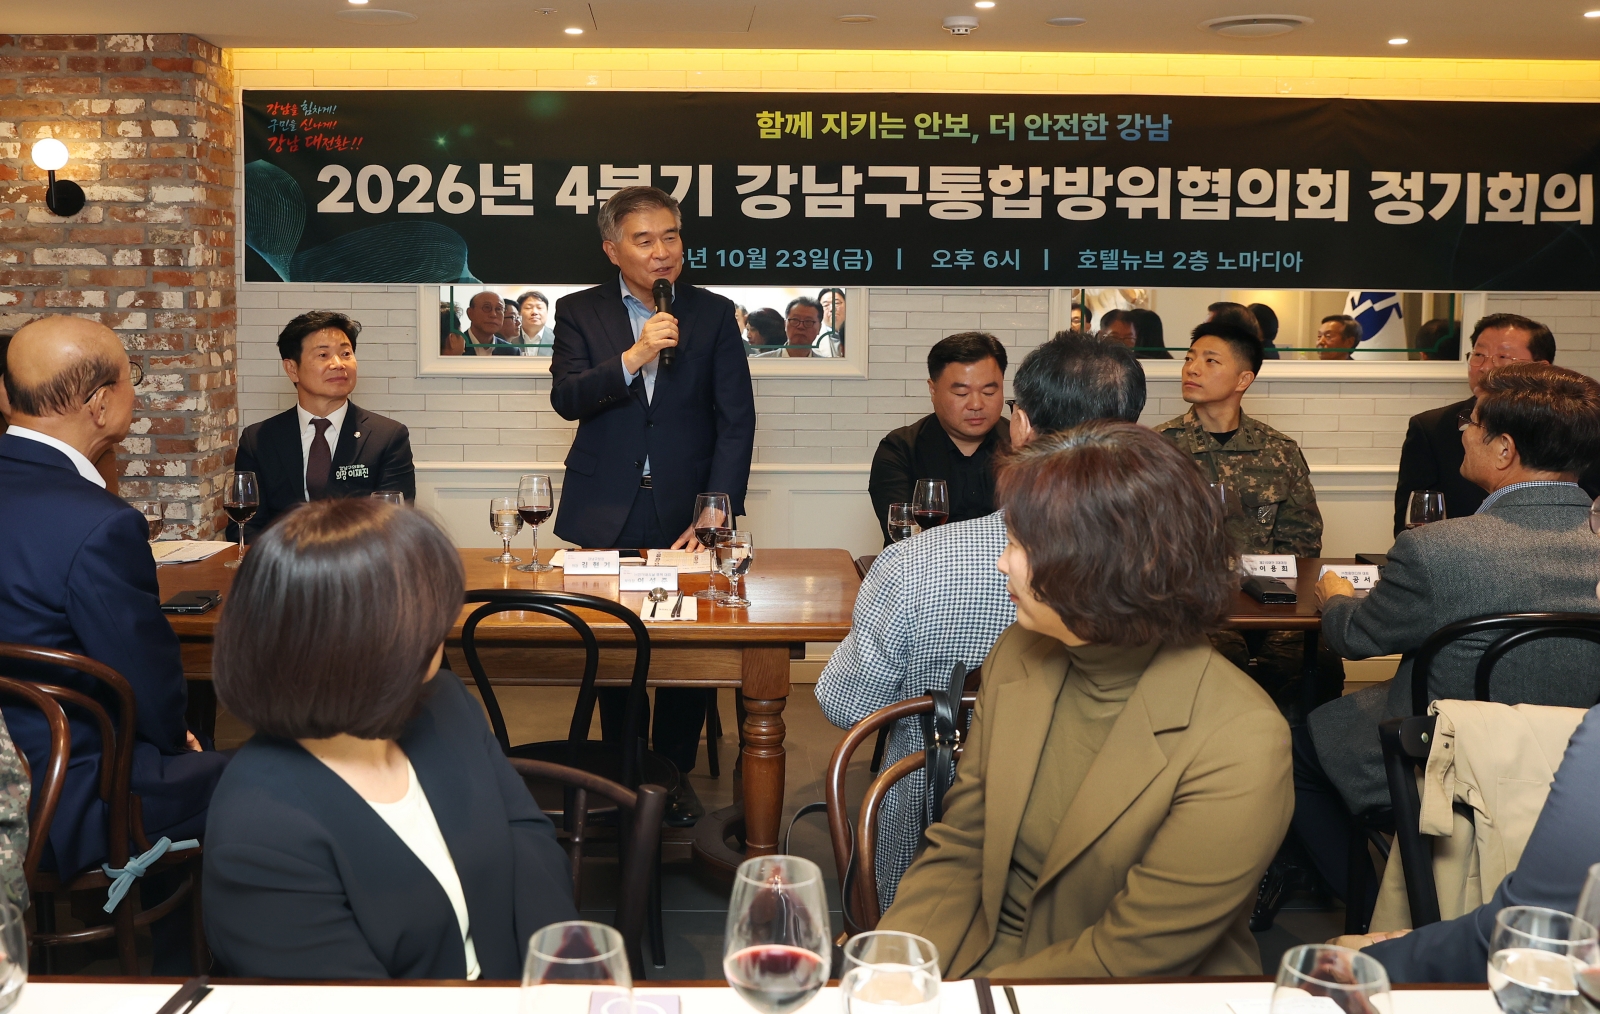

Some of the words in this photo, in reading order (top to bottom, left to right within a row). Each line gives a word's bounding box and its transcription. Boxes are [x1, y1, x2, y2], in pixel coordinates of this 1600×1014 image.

[266, 101, 299, 116] 강남을
[300, 100, 337, 116] 힘차게!
[267, 119, 297, 133] 구민을
[300, 118, 337, 131] 신나게!
[755, 111, 813, 140] 함께
[820, 111, 907, 140] 지키는
[913, 111, 979, 144] 안보,
[989, 112, 1015, 141] 더
[1024, 112, 1109, 141] 안전한
[1116, 113, 1173, 142] 강남
[267, 134, 300, 153] 강남
[304, 133, 364, 151] 대전환!!
[316, 163, 535, 216] 2026년
[735, 164, 1350, 222] 강남구통합방위협의회
[1368, 170, 1594, 225] 정기회의
[716, 247, 767, 269] 10월
[775, 247, 873, 272] 23일(금)
[931, 248, 976, 270] 오후
[983, 248, 1020, 271] 6시
[1077, 248, 1165, 271] 호텔뉴브
[1172, 250, 1209, 272] 2층
[1216, 250, 1304, 273] 노마디아
[348, 468, 369, 478] 이재진
